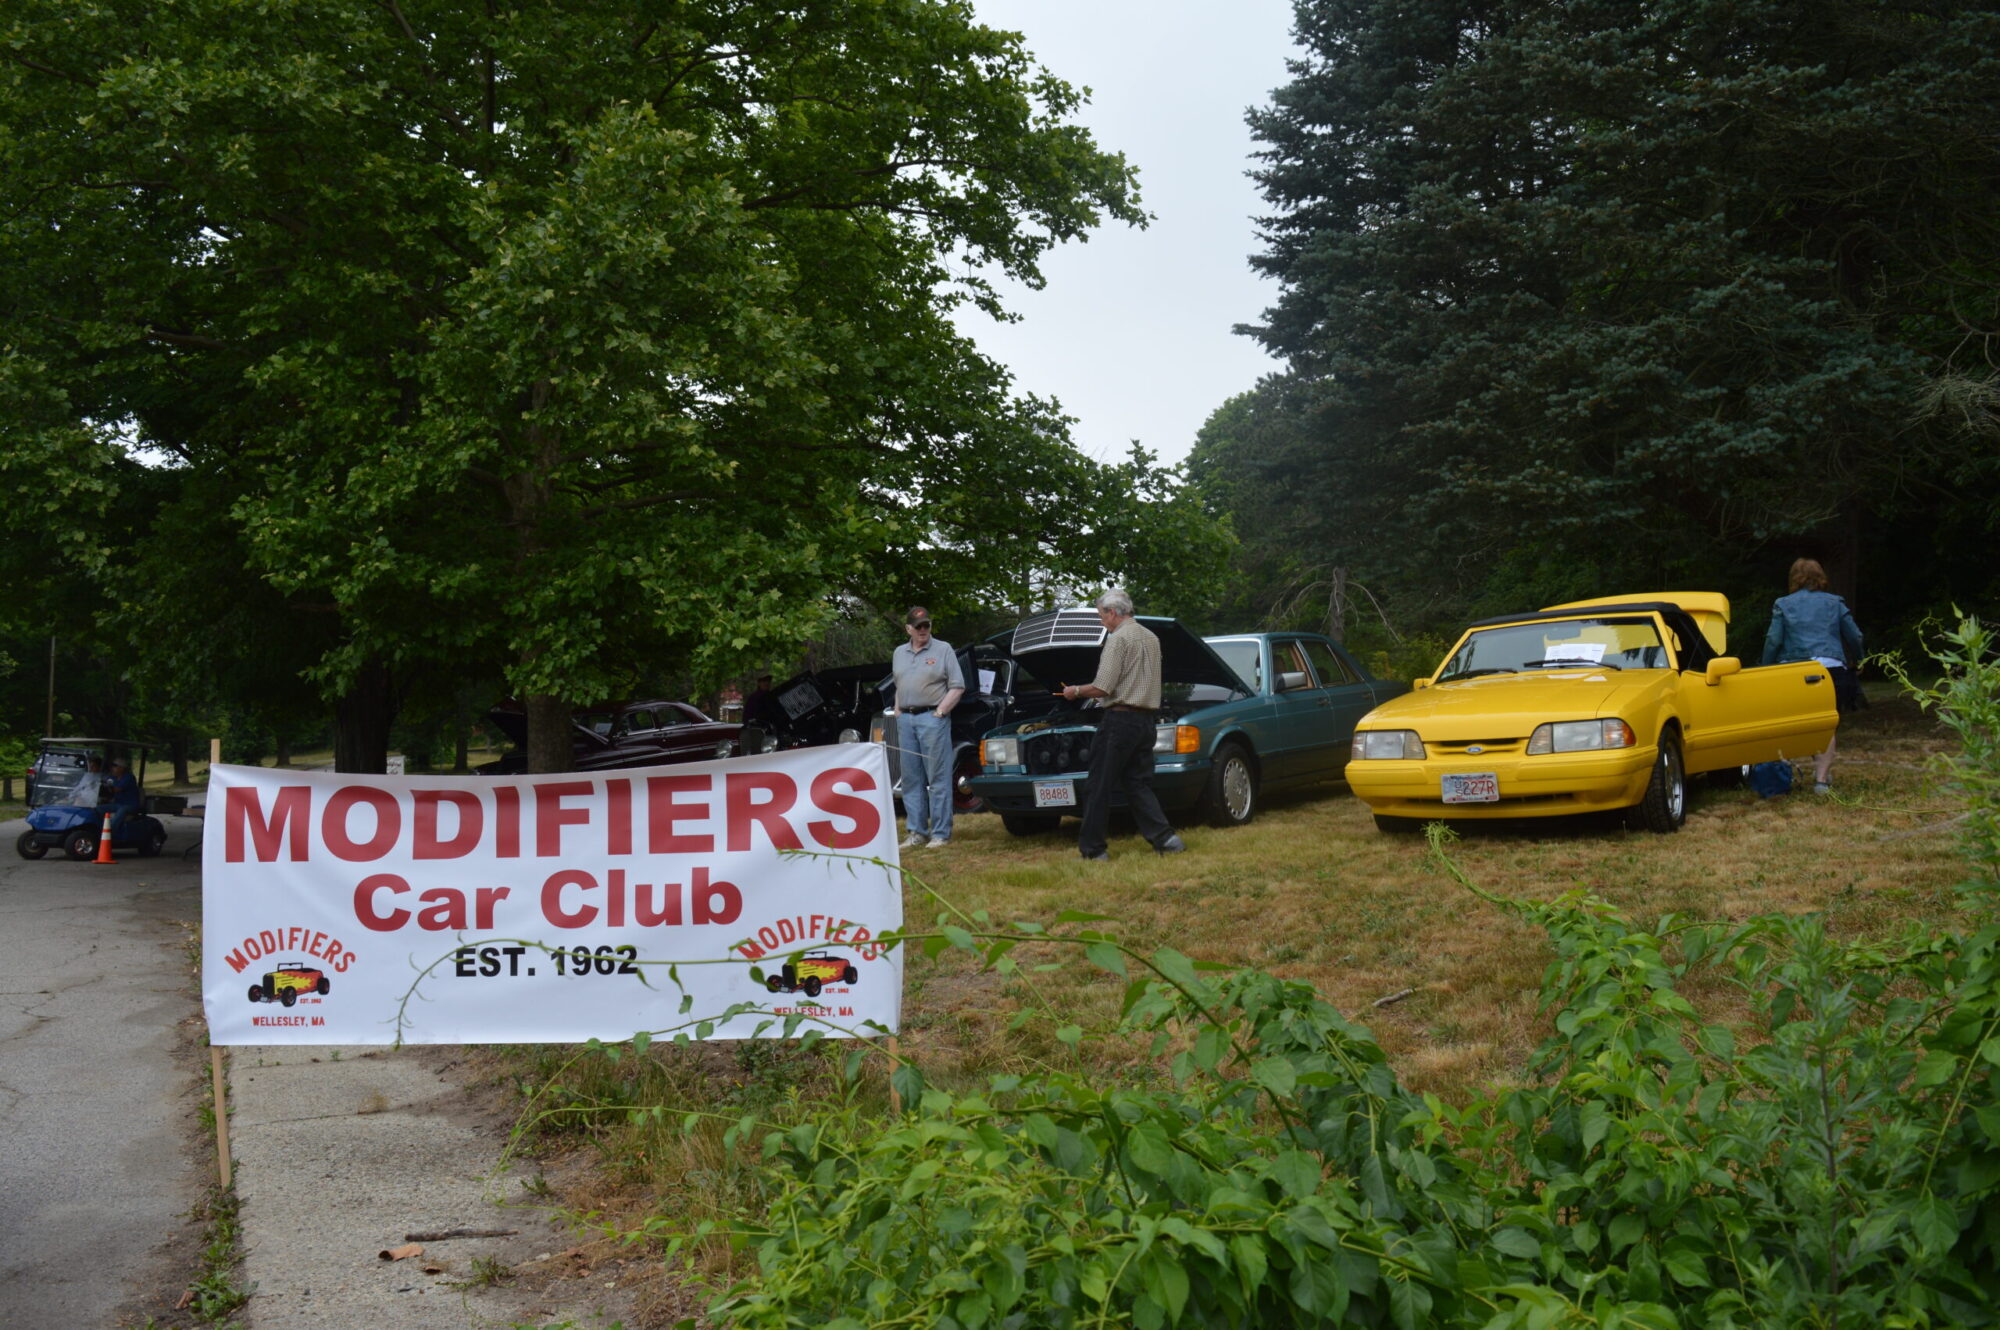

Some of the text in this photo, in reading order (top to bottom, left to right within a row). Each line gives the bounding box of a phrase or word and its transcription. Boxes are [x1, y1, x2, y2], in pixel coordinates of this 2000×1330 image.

[1040, 788, 1069, 800] 88488
[225, 768, 881, 864] MODIFIERS
[353, 867, 743, 932] Car Club
[224, 927, 356, 973] MODIFIERS
[737, 914, 886, 963] MODIFIERS
[456, 946, 638, 977] EST. 1962
[252, 1016, 325, 1027] WELLESLEY, MA
[839, 1007, 854, 1017] MA
